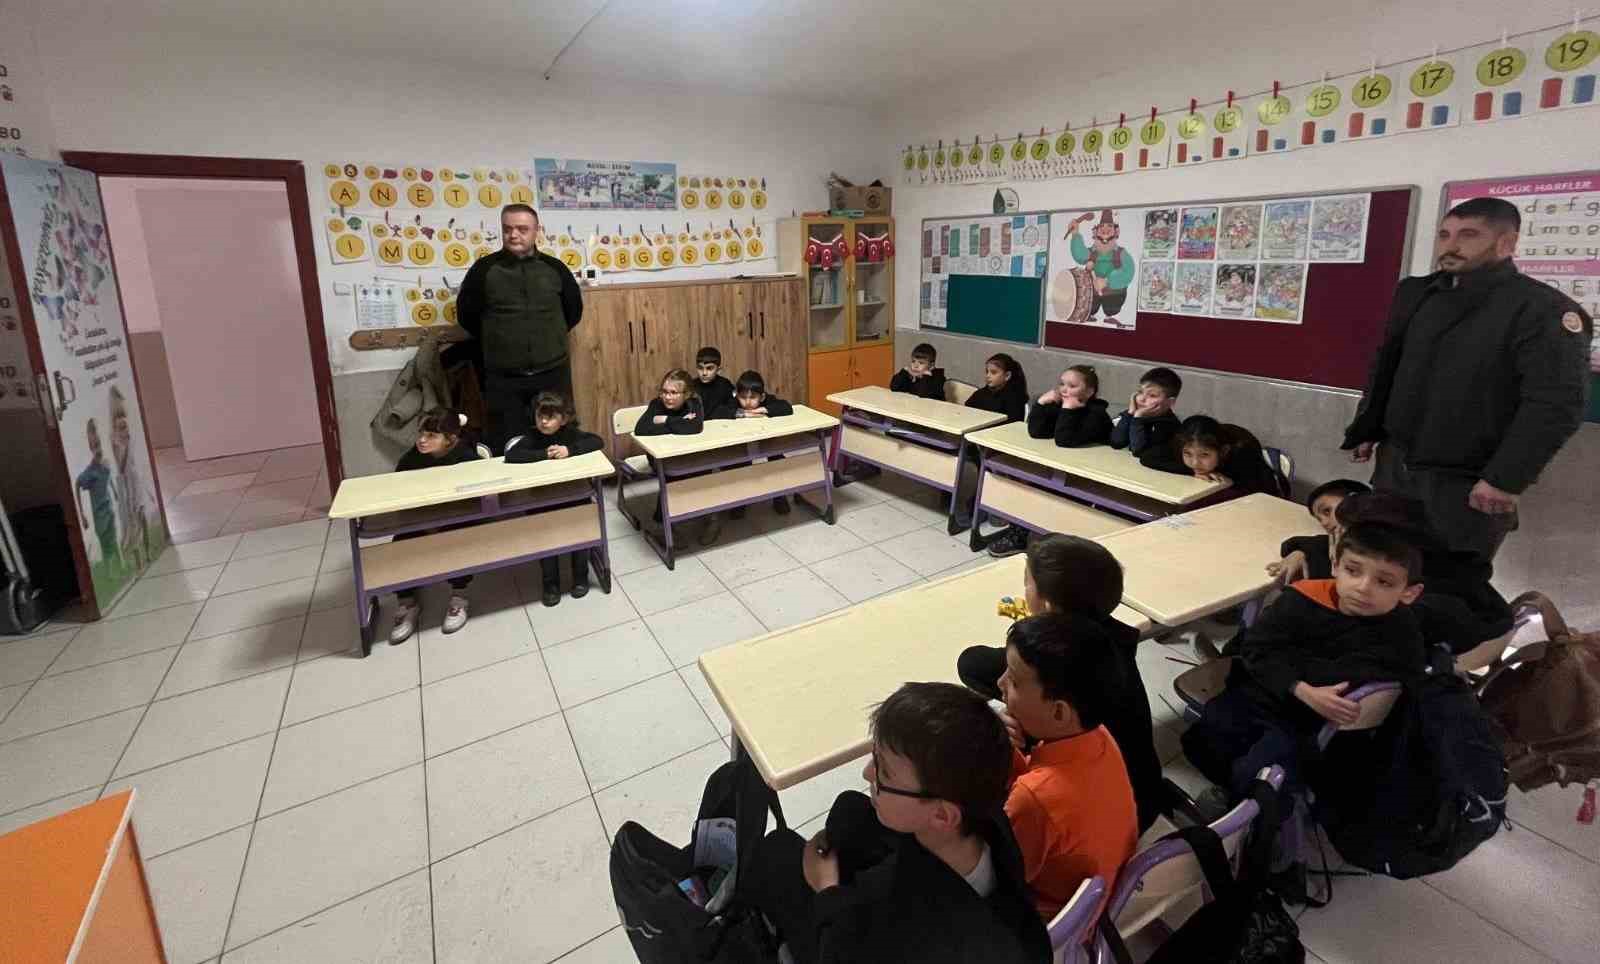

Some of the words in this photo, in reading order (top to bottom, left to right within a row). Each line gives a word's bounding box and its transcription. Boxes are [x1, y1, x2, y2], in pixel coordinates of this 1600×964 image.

[1035, 143, 1045, 154] 7
[1062, 138, 1068, 150] 8
[1089, 134, 1097, 148] 9
[1113, 130, 1128, 145] 10
[1148, 125, 1157, 141] 11
[1185, 119, 1199, 134] 12
[1222, 111, 1237, 128] 13
[1265, 101, 1284, 119] 14
[1312, 91, 1335, 111] 15
[1361, 81, 1382, 101] 16
[1420, 67, 1445, 90] 17
[1487, 55, 1514, 79] 18
[1558, 39, 1590, 64] 19
[1534, 180, 1593, 192] HARFLER
[339, 187, 353, 201] A
[376, 187, 390, 201] N
[416, 189, 426, 202] E
[451, 188, 460, 202] T
[518, 190, 528, 202] L
[710, 194, 718, 205] K
[1524, 199, 1538, 214] d
[1563, 196, 1579, 211] f
[1543, 226, 1560, 235] m
[384, 245, 401, 258] M
[415, 243, 426, 260] Ü
[452, 248, 462, 262] S
[565, 253, 576, 266] Z
[619, 252, 627, 264] B
[638, 251, 649, 263] G
[710, 247, 717, 258] P
[729, 246, 739, 256] H
[750, 242, 760, 253] V
[417, 305, 431, 321] Ğ
